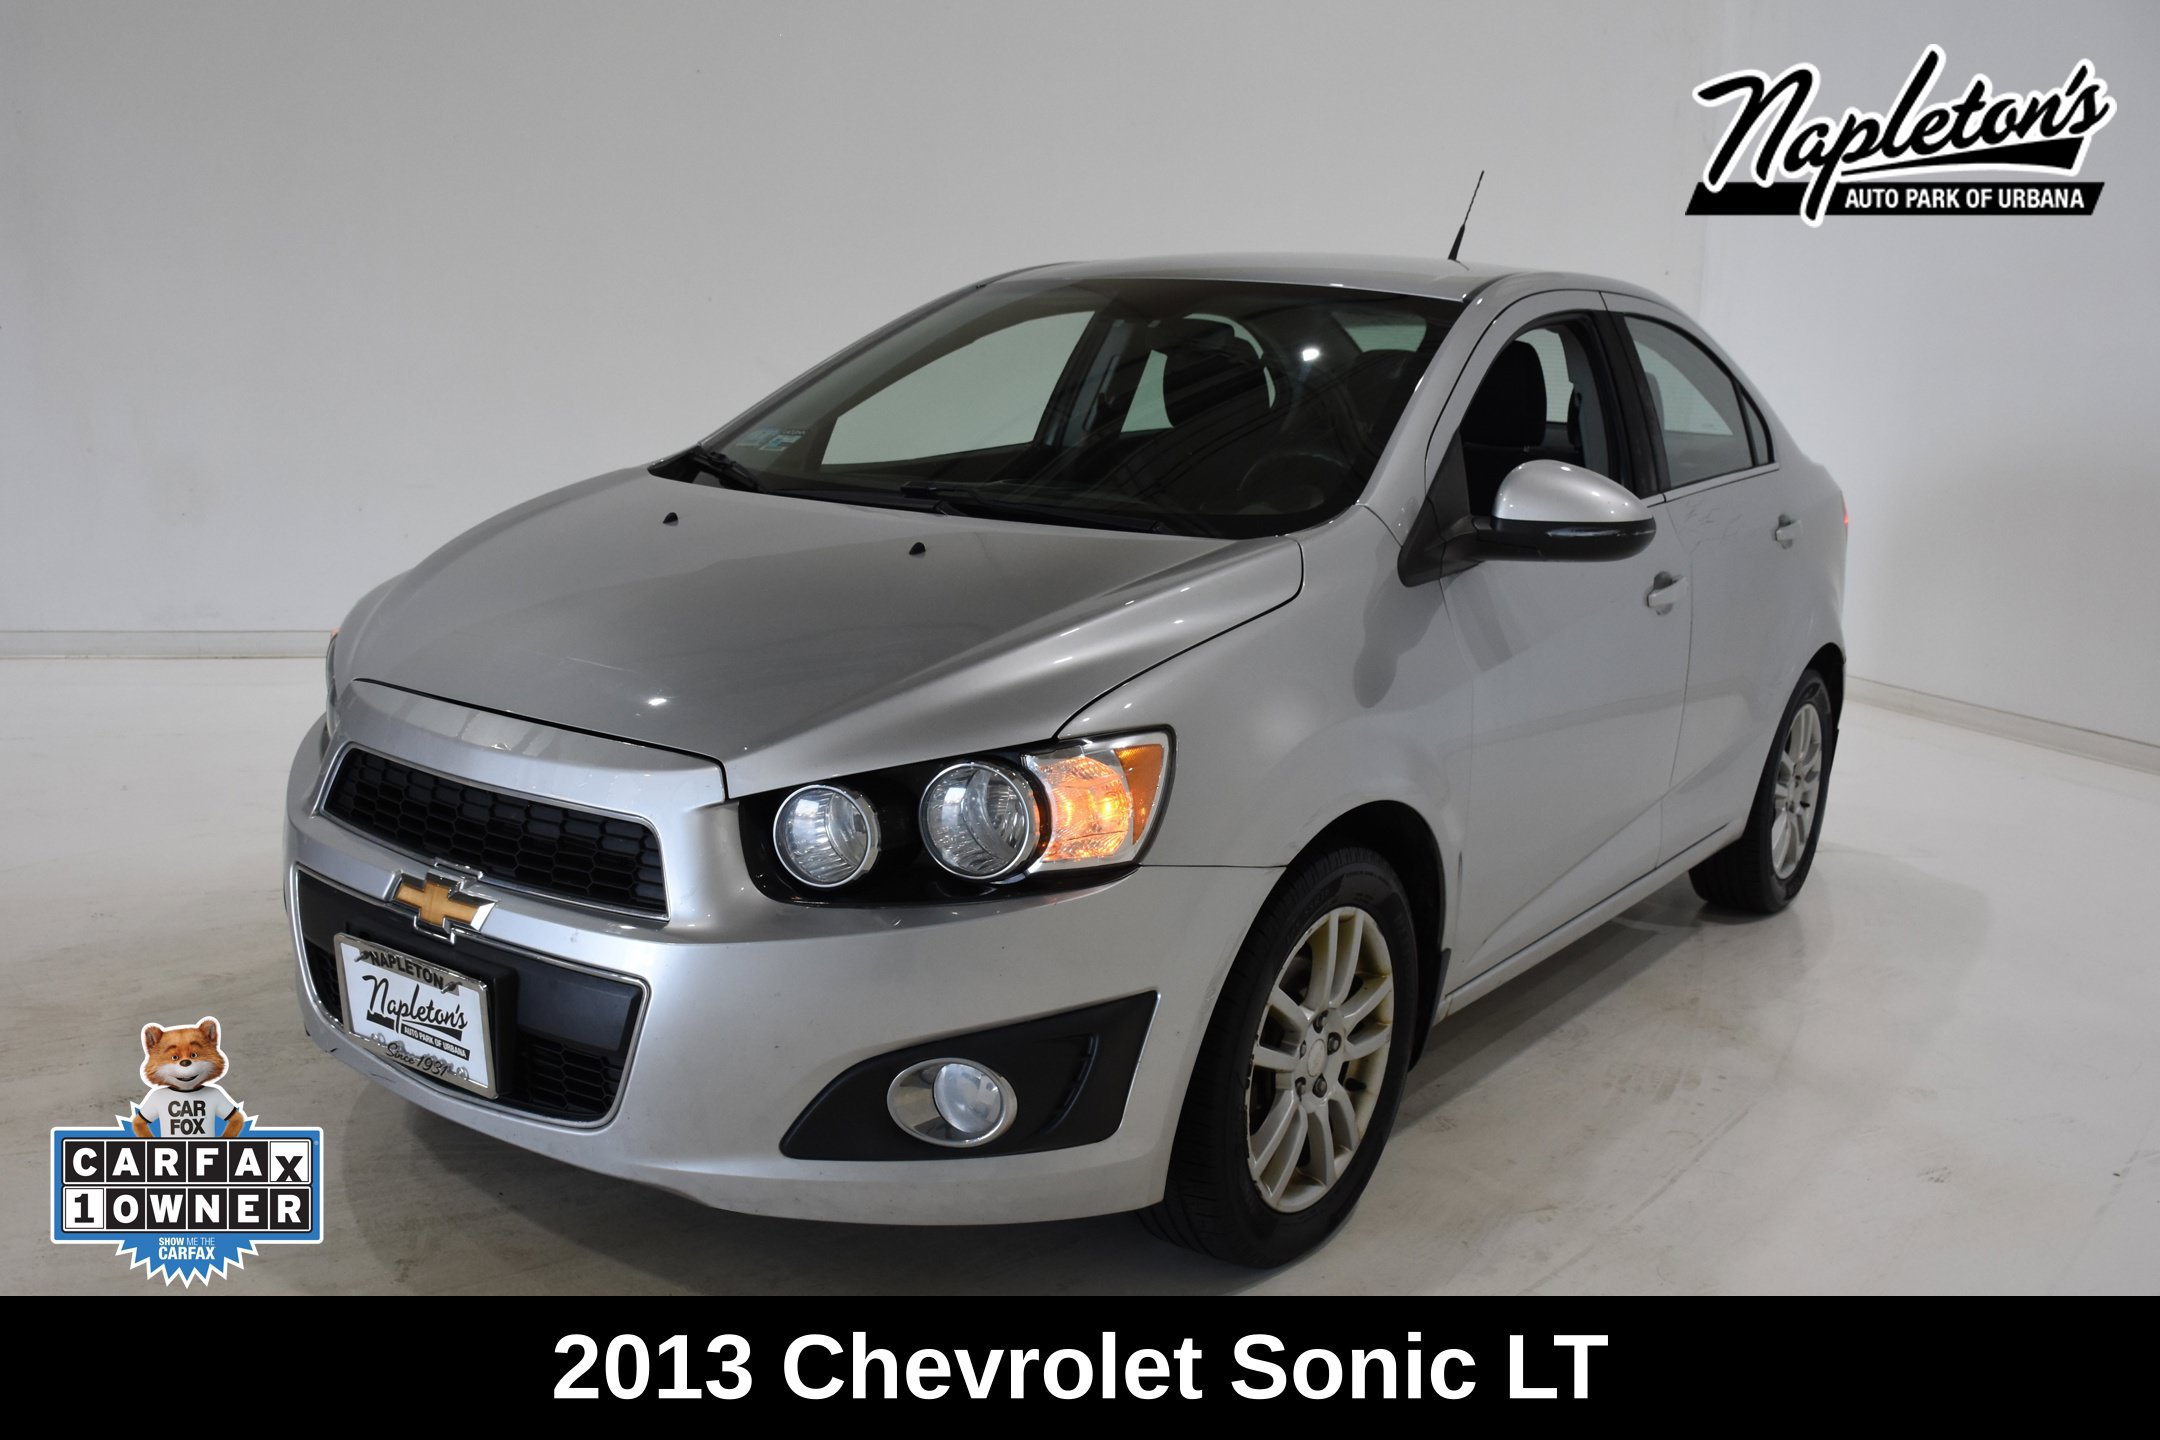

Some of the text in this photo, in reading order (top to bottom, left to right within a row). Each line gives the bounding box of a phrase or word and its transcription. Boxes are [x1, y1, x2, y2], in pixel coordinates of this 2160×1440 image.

[368, 952, 444, 990] NAPLETON
[362, 975, 468, 1034] Napleton's
[385, 1042, 449, 1077] Since 1931
[403, 1025, 468, 1058] AUTO PARK OF URBANA
